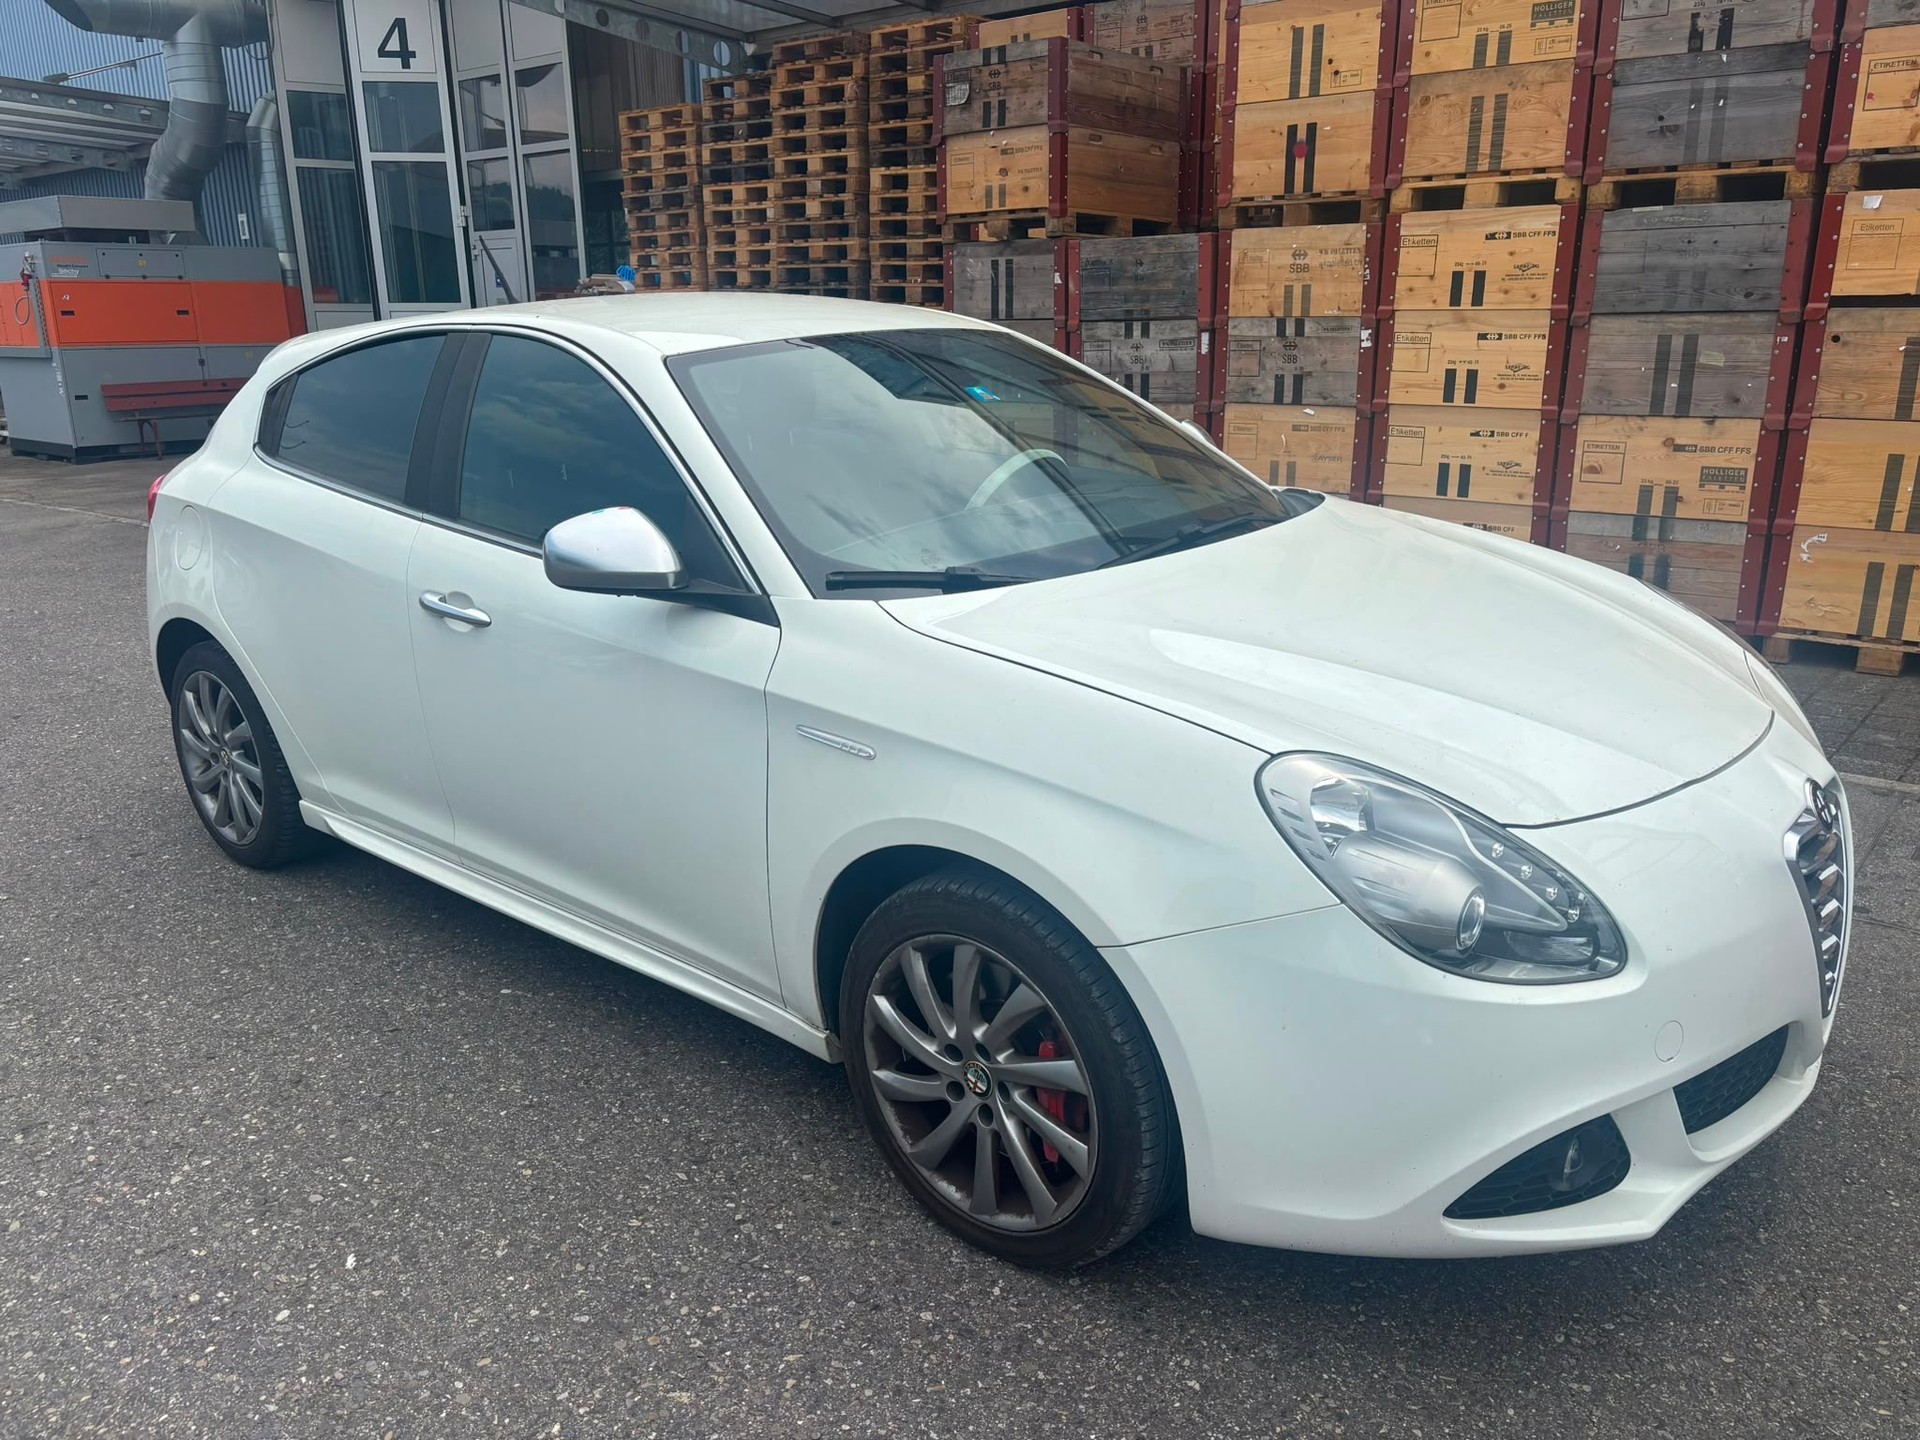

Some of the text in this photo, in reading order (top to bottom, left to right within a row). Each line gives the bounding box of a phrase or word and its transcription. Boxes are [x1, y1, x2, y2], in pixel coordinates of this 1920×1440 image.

[1534, 1, 1573, 12] HOLLIGER
[377, 17, 417, 70] 4
[1873, 59, 1919, 69] ETIKETTEN
[1860, 222, 1896, 232] Etiketten
[1512, 231, 1527, 239] SBB
[1289, 262, 1310, 274] SBB
[1282, 354, 1298, 364] SBB
[1698, 445, 1752, 455] SBB CFF FFS
[1702, 468, 1746, 477] HOLLIGER
